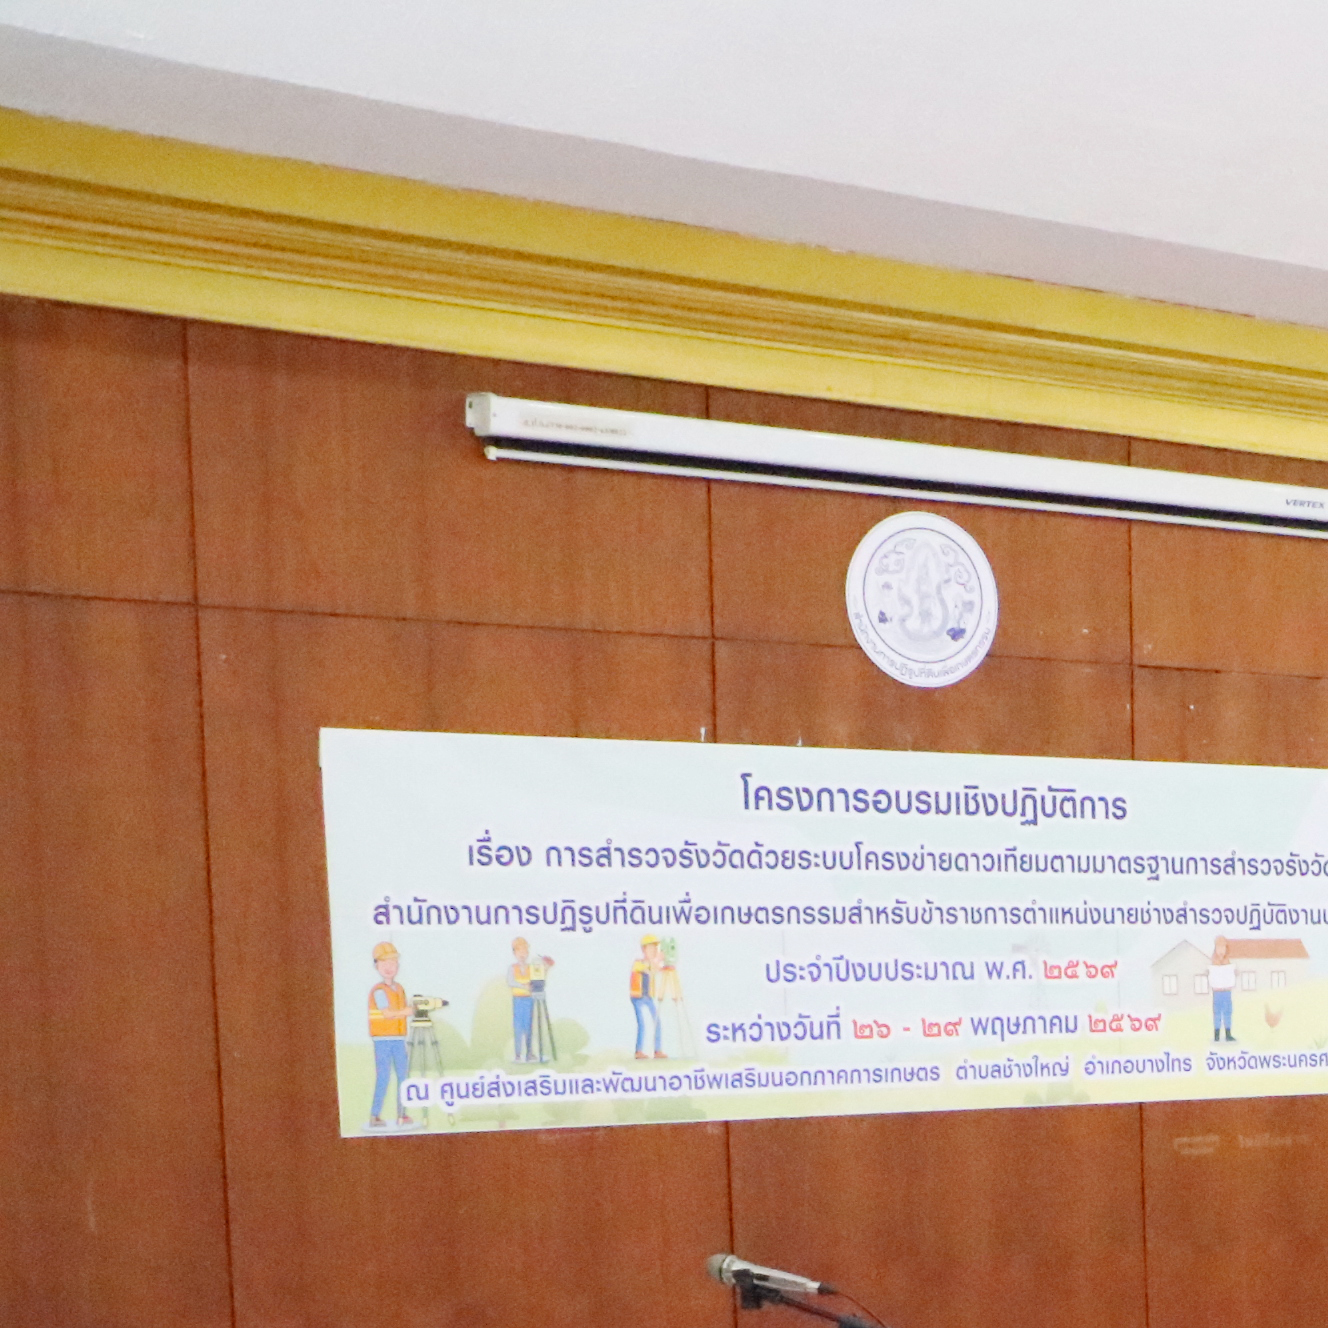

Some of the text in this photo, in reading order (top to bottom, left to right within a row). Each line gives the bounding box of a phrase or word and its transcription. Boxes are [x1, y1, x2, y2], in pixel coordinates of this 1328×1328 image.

[1285, 499, 1325, 509] VERTEX
[740, 772, 1128, 826] โครงการอบรมเชิงปฏิบัติการ
[468, 829, 533, 867] เรื่อง
[765, 954, 1118, 985] ประจำปีงบประมาณ พ.ศ. ๒๕๖๙
[706, 1007, 841, 1044] ระหว่างวันที่
[852, 1019, 892, 1041] ๒๖
[921, 1017, 963, 1039] ๒๙
[970, 1013, 1079, 1041] พฤษภาคม
[1087, 1013, 1163, 1034] ๒๕๖๙
[404, 1078, 429, 1102] ณ
[440, 1064, 941, 1107] ศูนย์ส่งเสริมและพัฒนาอาชีพเสริมนอกภาคการเกษตร
[955, 1055, 1070, 1082] ตำบลช้างใหญ่
[1083, 1051, 1193, 1077] อำเภอบางไทร
